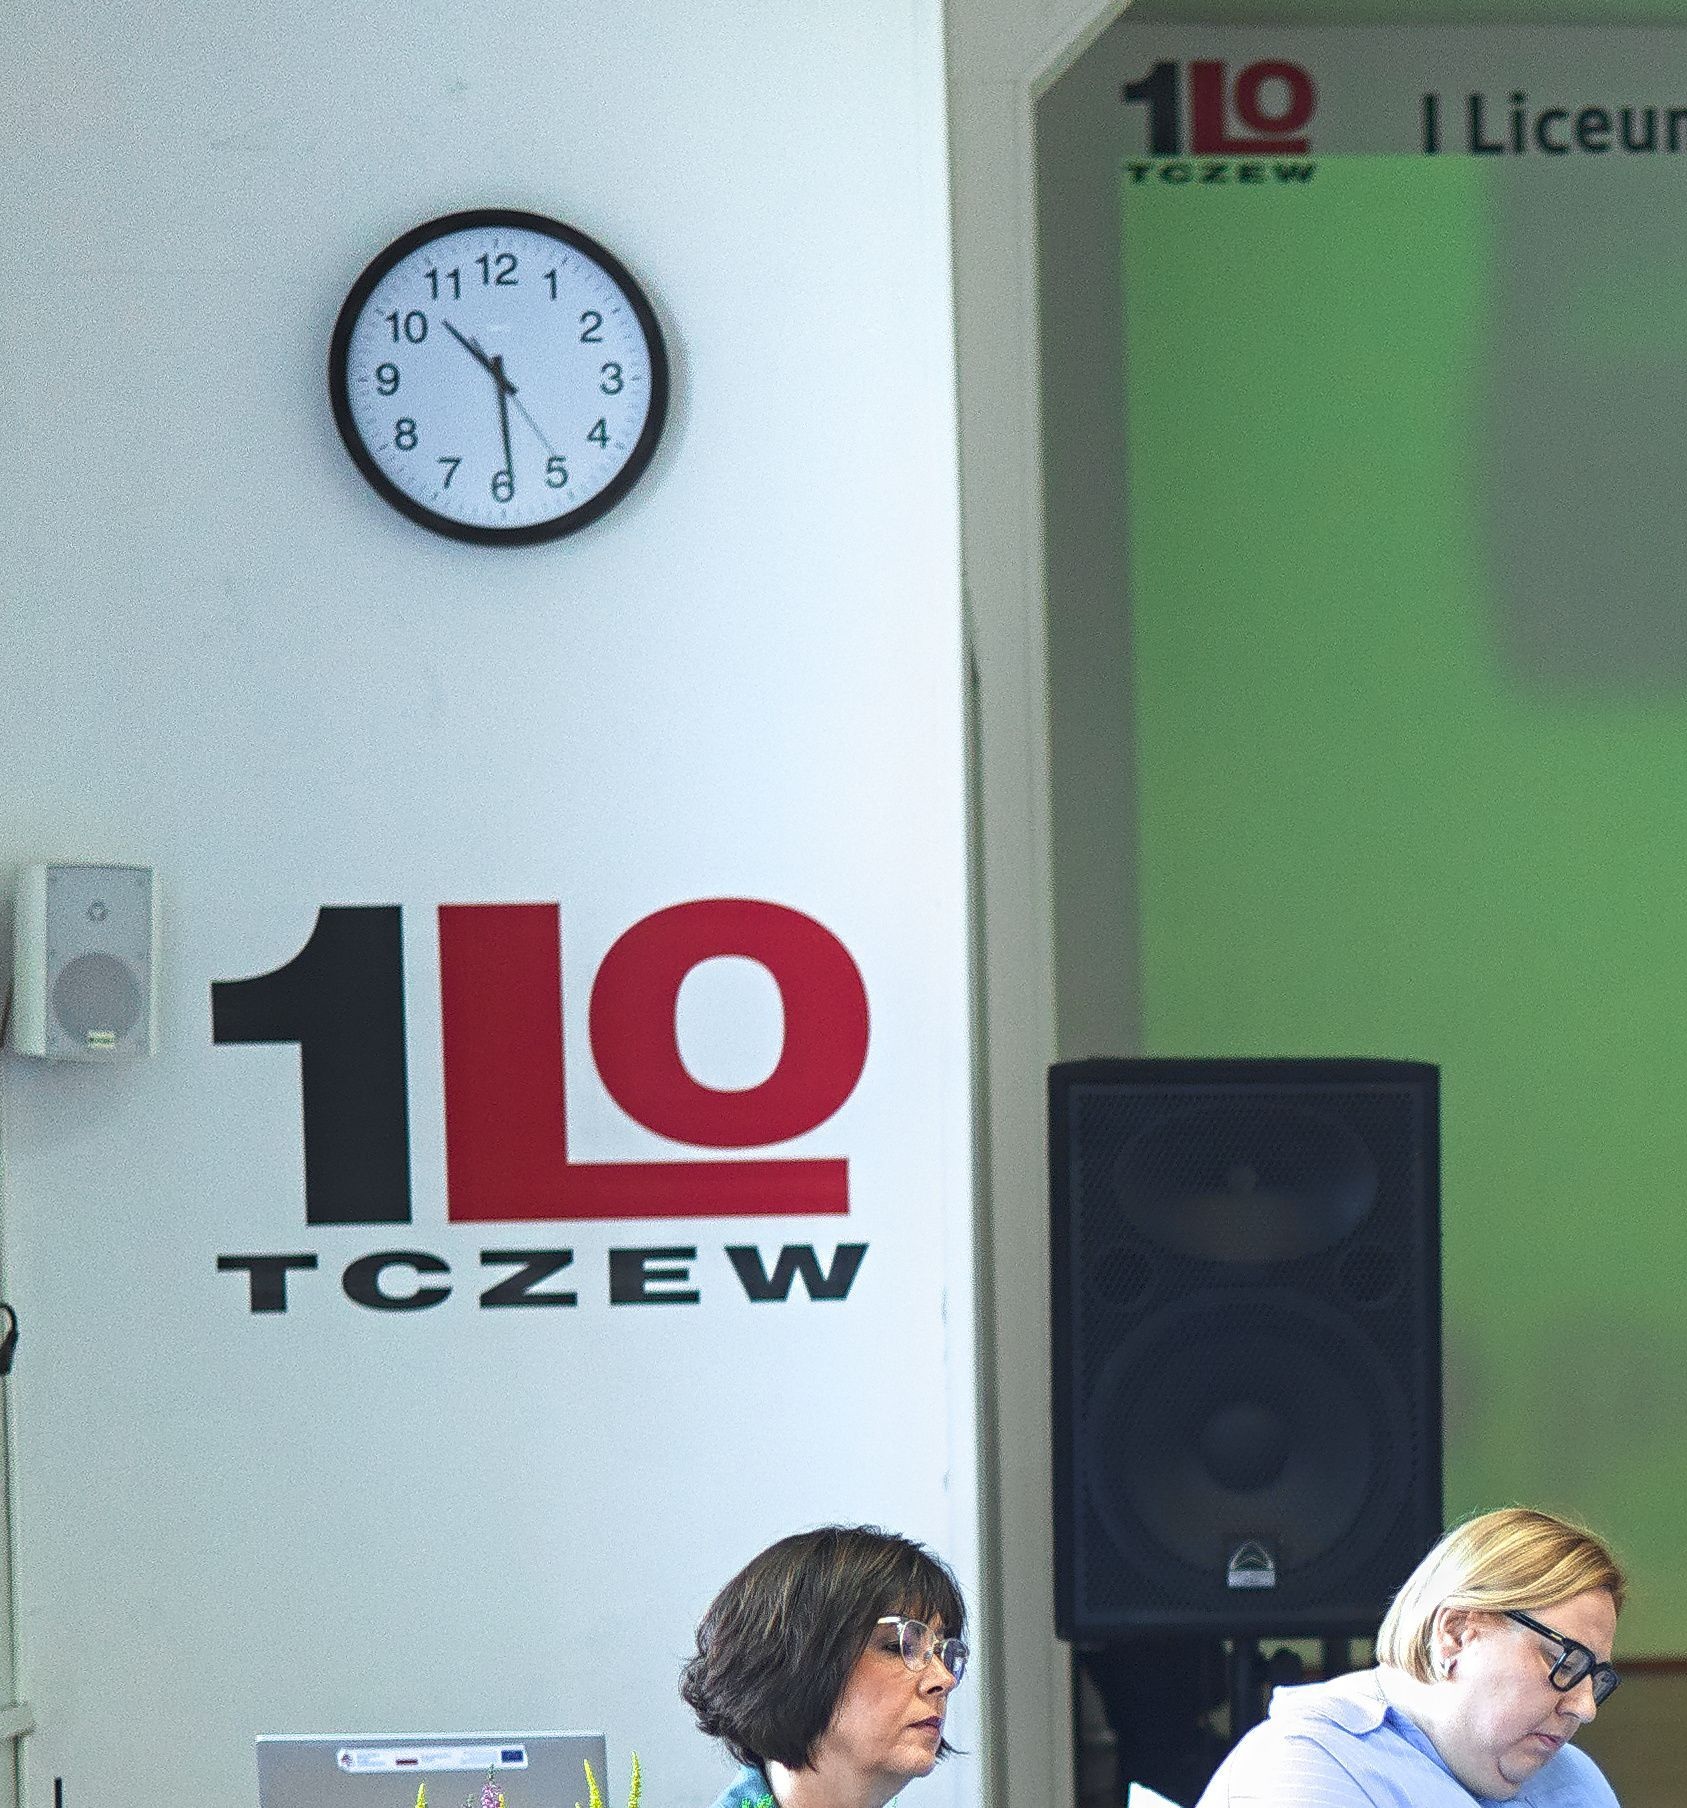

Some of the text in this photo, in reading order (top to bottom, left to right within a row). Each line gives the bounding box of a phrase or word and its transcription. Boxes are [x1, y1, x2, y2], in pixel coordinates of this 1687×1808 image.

[1123, 58, 1318, 157] 1LO
[1421, 91, 1440, 154] I
[1126, 160, 1318, 186] TCZEW
[425, 268, 462, 301] 11
[475, 252, 519, 286] 12
[544, 268, 559, 301] 1
[386, 310, 429, 344] 10
[578, 310, 604, 344] 2
[375, 361, 401, 397] 9
[600, 361, 624, 396] 3
[394, 416, 419, 452] 8
[586, 417, 610, 450] 4
[437, 456, 463, 490] 7
[490, 470, 516, 503] 6
[545, 455, 570, 489] 5
[211, 896, 871, 1227] 1LO
[216, 1242, 870, 1315] TCZEW
